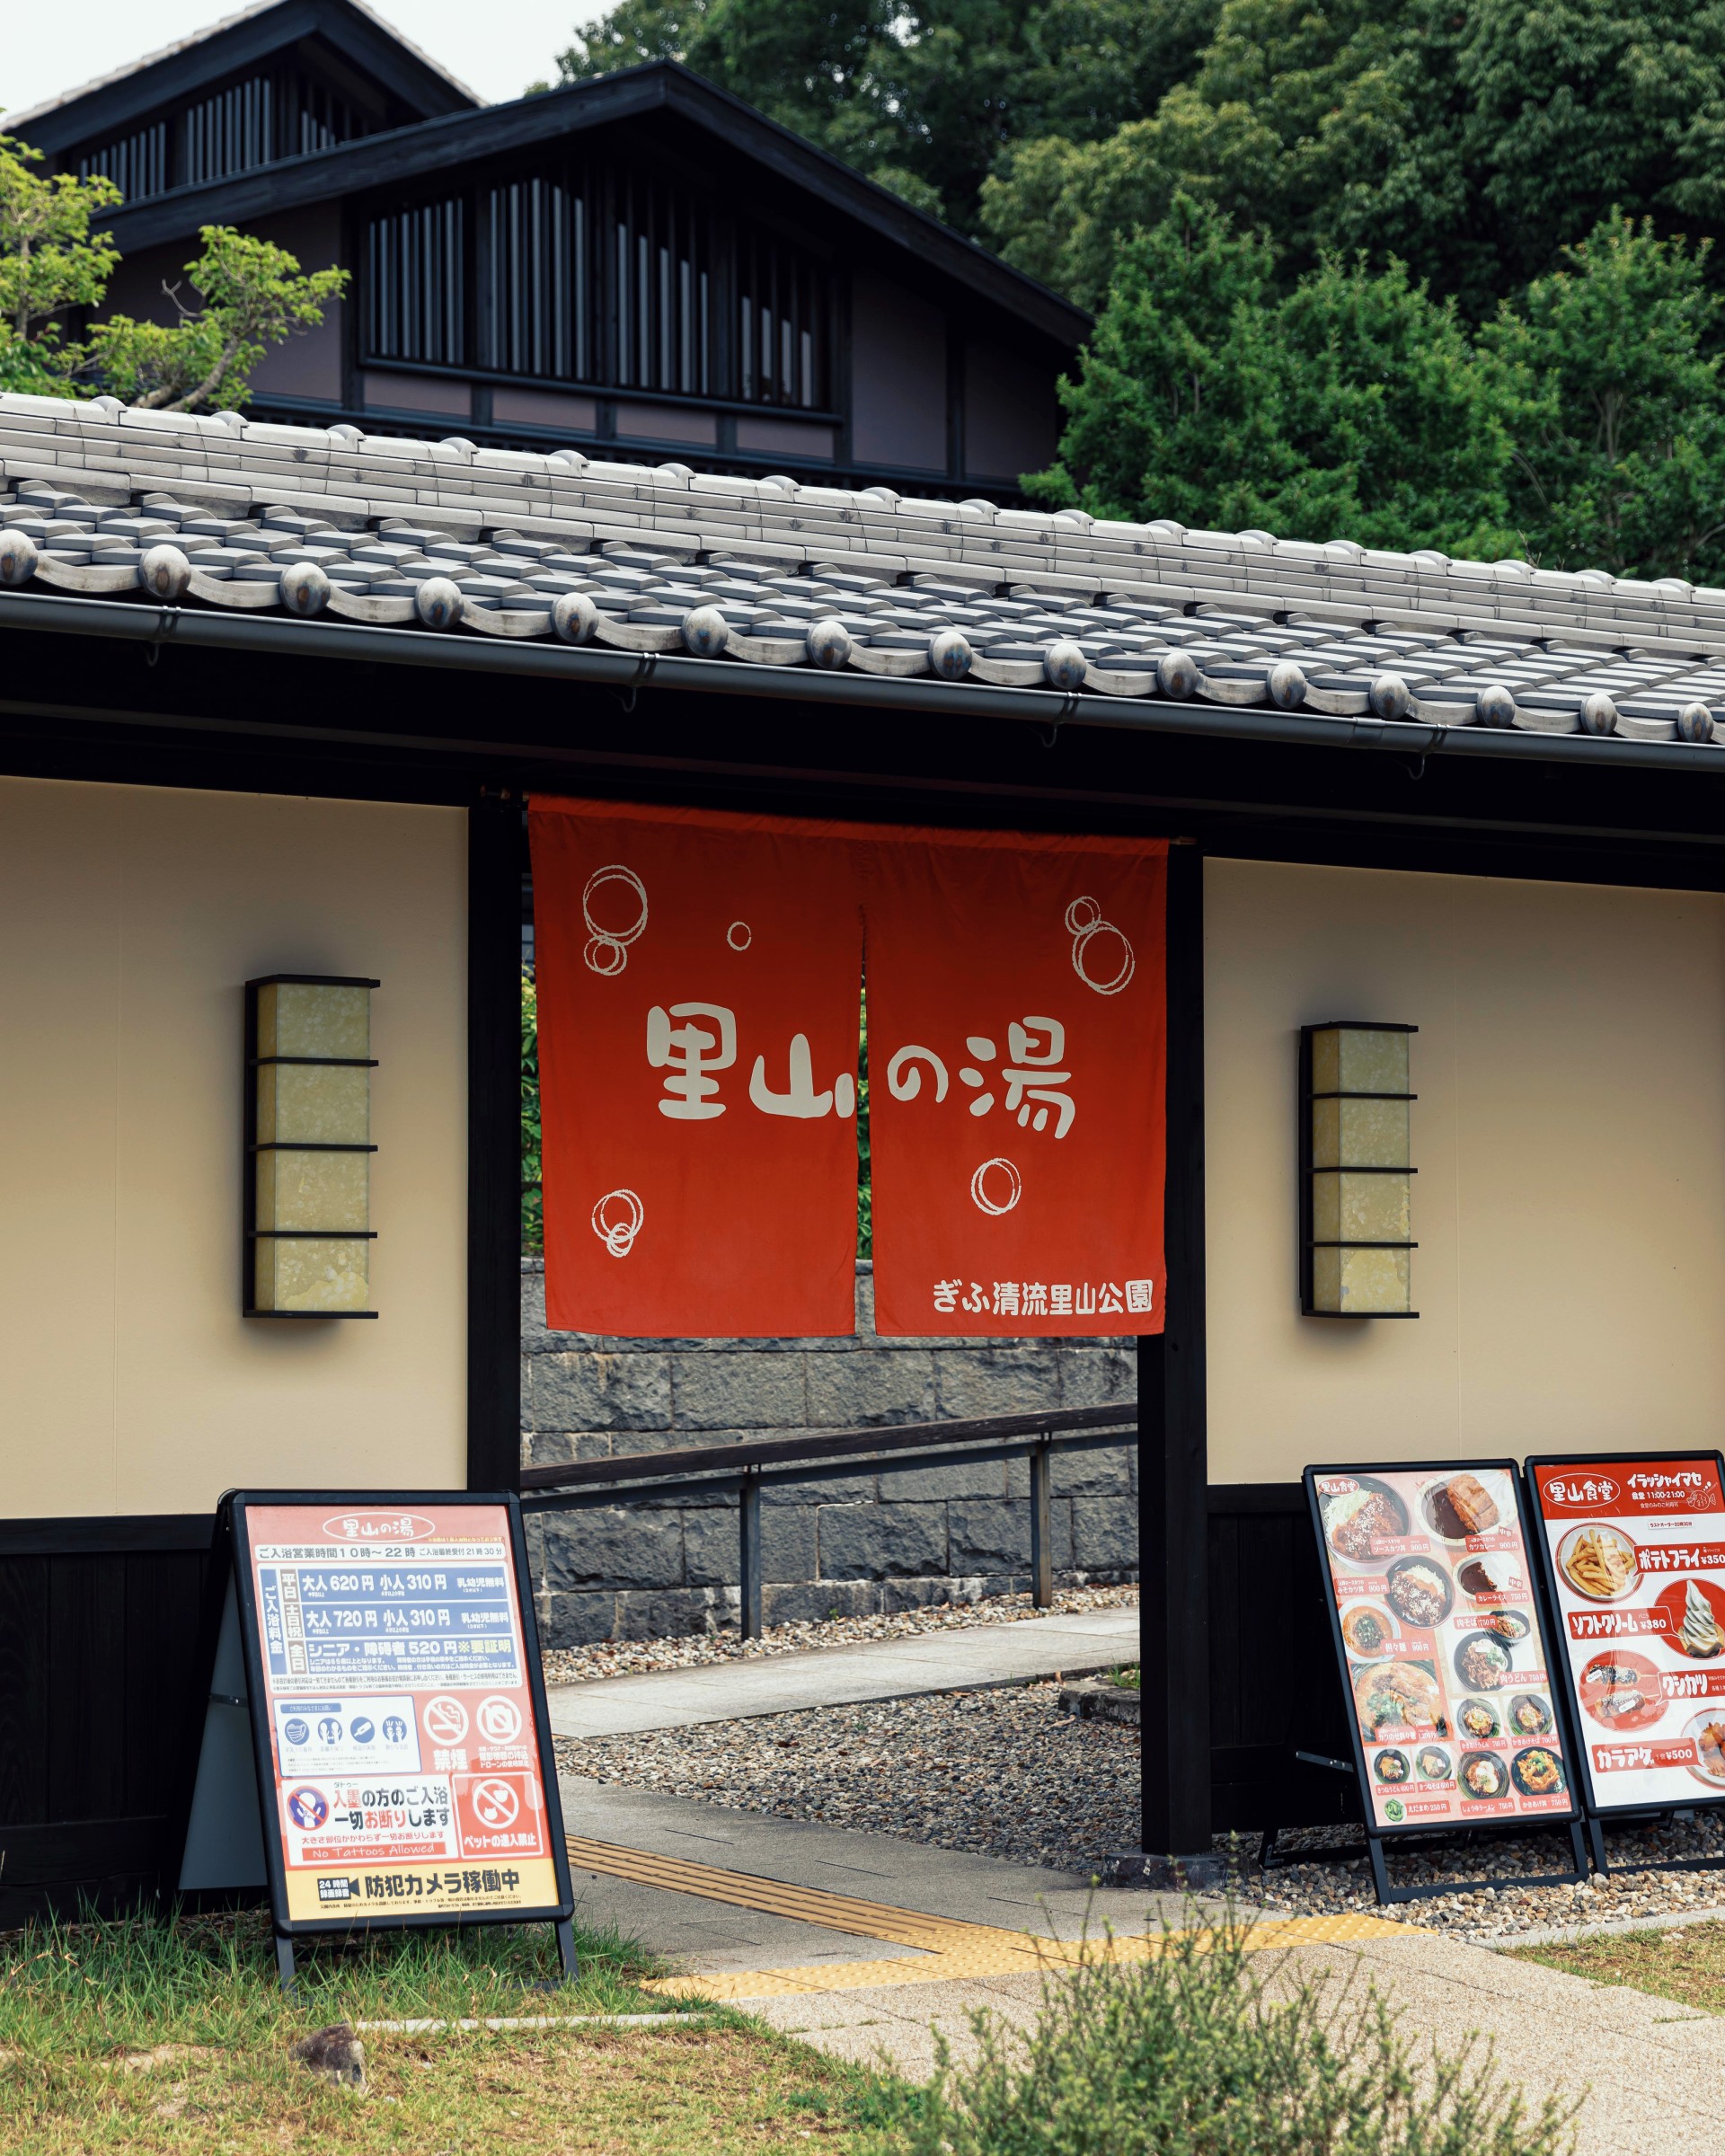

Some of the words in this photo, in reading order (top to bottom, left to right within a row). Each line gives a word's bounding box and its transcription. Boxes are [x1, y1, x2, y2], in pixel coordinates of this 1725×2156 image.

[647, 1002, 1075, 1139] 里山の湯
[933, 1278, 1154, 1316] ぎふ清流里山公園
[1321, 1480, 1356, 1492] 里山食堂
[1627, 1471, 1702, 1488] イラッシャイマセ
[1550, 1480, 1614, 1502] 里山食堂
[342, 1516, 414, 1538] 里山の湯
[1638, 1548, 1700, 1570] ポテトフライ
[281, 1574, 297, 1600] 平日
[1571, 1613, 1639, 1635] ソフトクリーム
[1640, 1619, 1667, 1630] ¥380
[433, 1748, 469, 1772] 禁煙
[1666, 1748, 1694, 1761] ¥500
[333, 1786, 448, 1809] 入墨の方のご入浴
[334, 1808, 450, 1830] 一切お断りします
[313, 1850, 329, 1859] No
[332, 1847, 385, 1858] Tattoos
[389, 1842, 435, 1855] Allowed
[365, 1869, 520, 1898] 防犯カメラ稼働中
